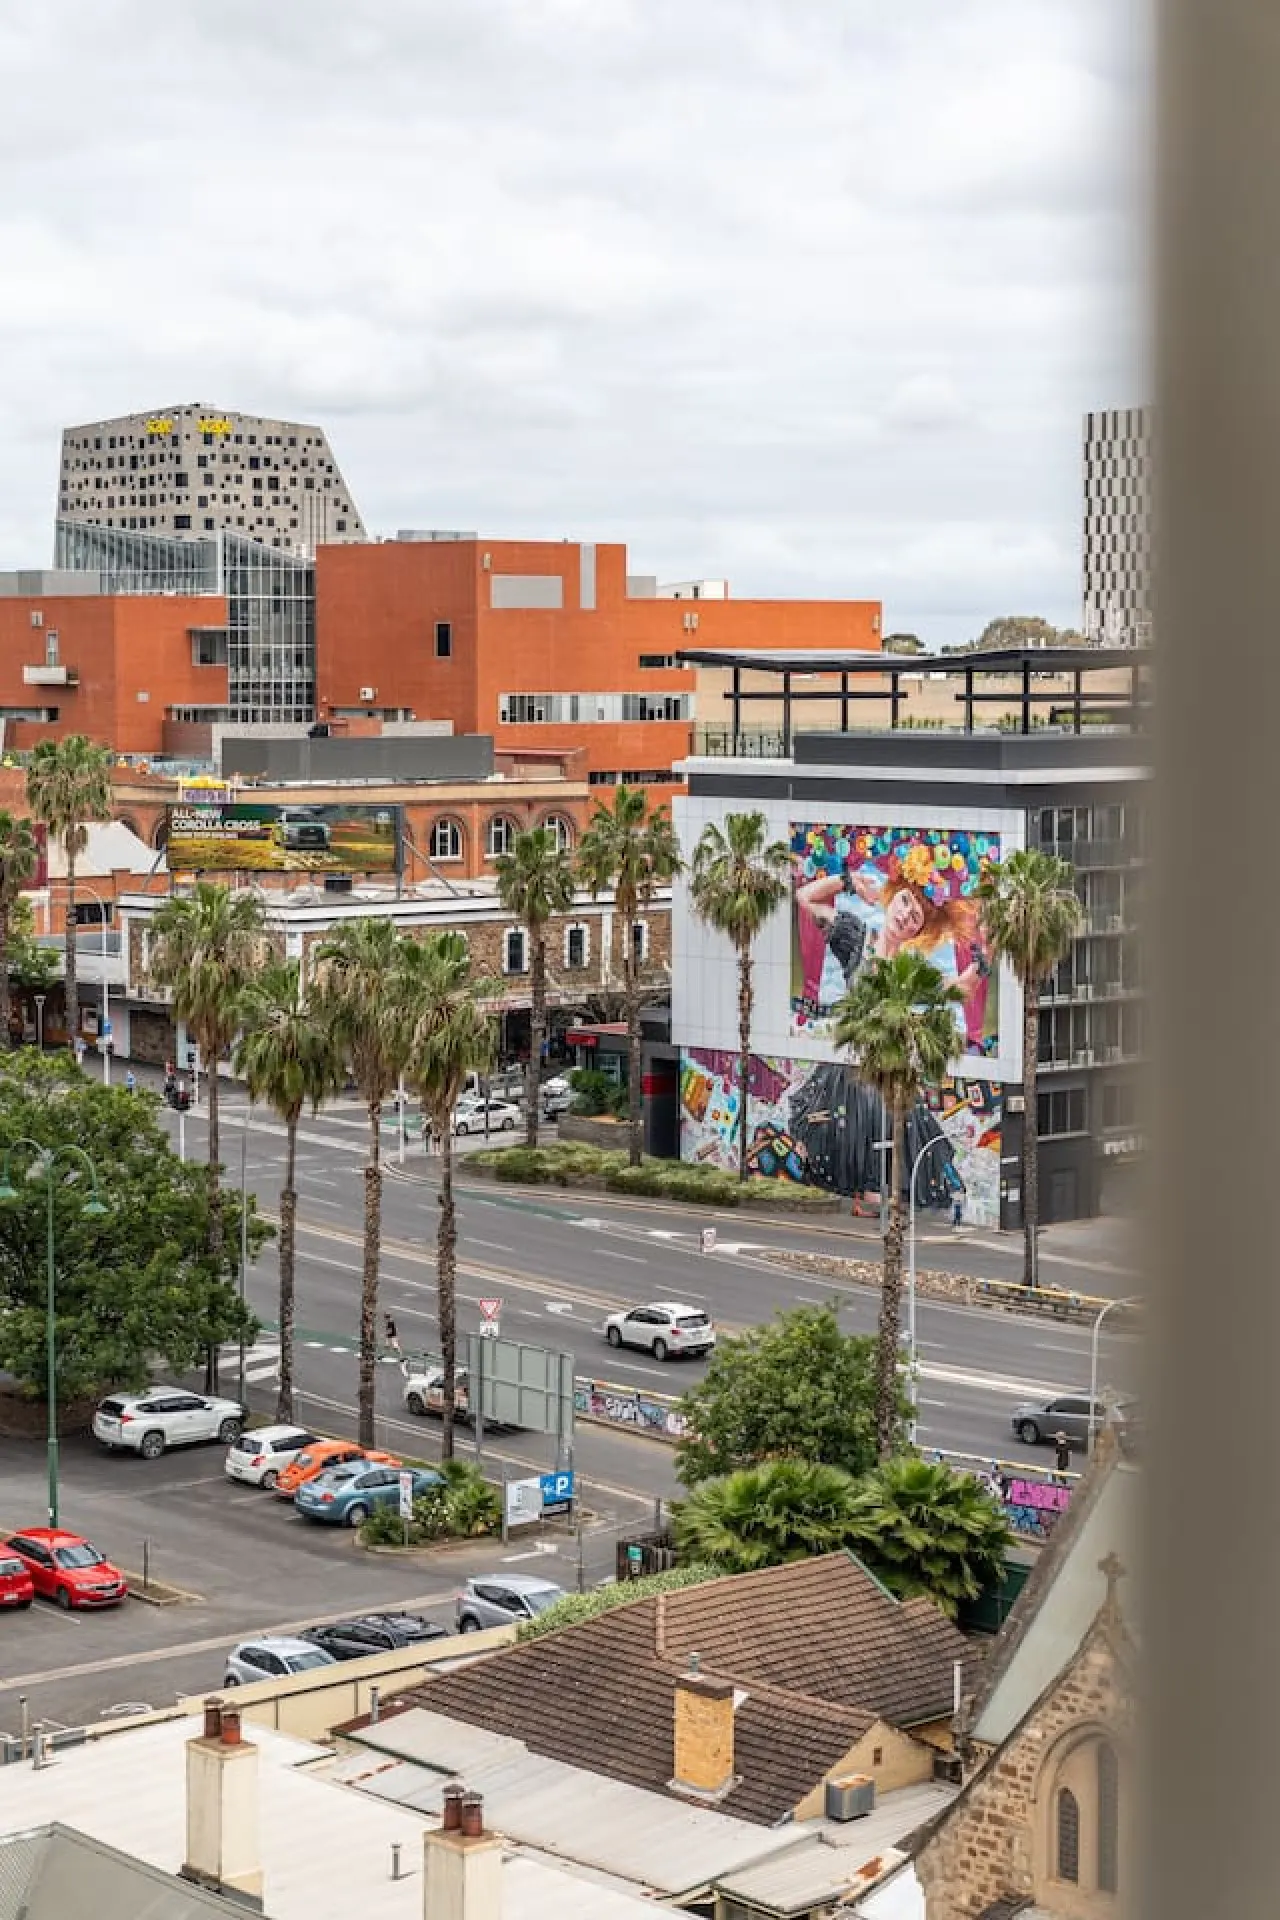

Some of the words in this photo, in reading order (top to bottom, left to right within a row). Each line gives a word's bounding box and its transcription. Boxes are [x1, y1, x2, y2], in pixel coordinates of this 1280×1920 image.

[172, 819, 221, 831] COROLLA
[224, 819, 261, 831] CROSS
[555, 1476, 569, 1497] P
